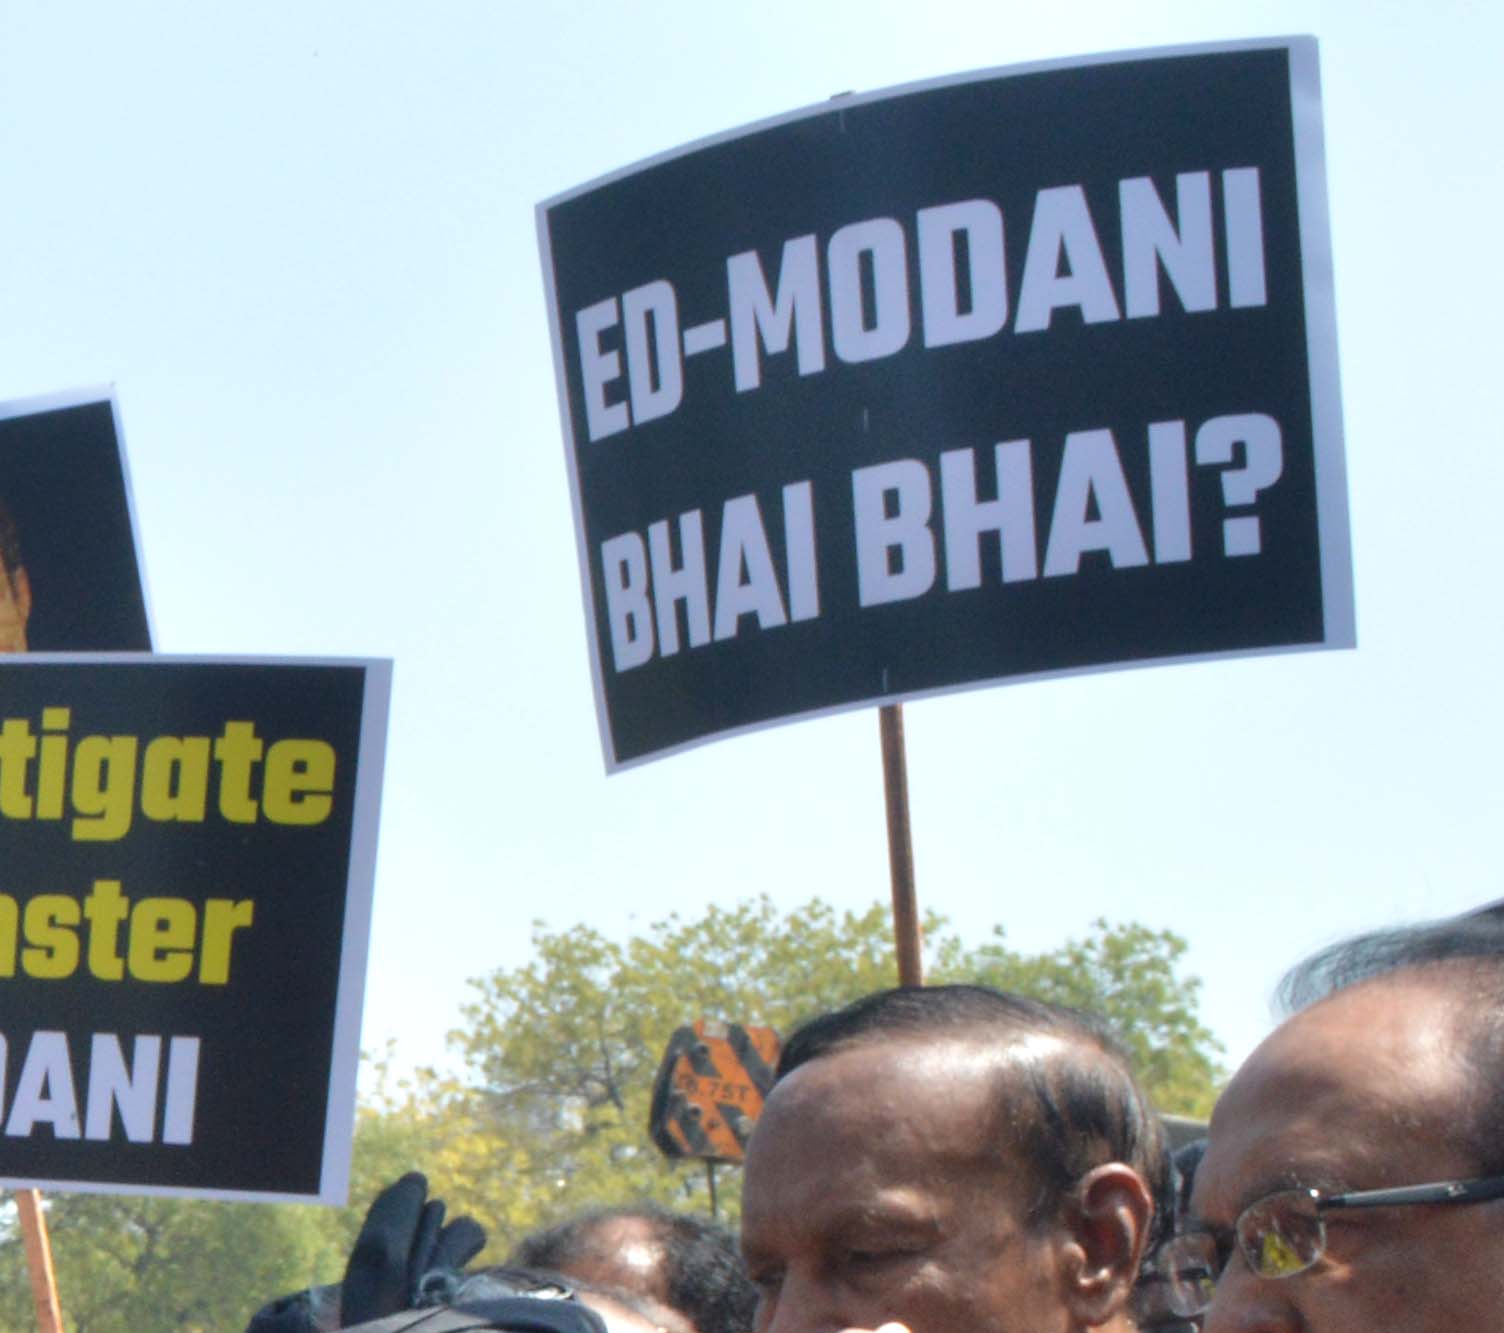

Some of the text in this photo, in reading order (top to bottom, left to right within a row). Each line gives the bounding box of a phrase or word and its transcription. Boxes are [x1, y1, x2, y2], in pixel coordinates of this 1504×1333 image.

[576, 166, 1268, 443] ED-MODANI
[601, 412, 1285, 673] BHAI BHAI?
